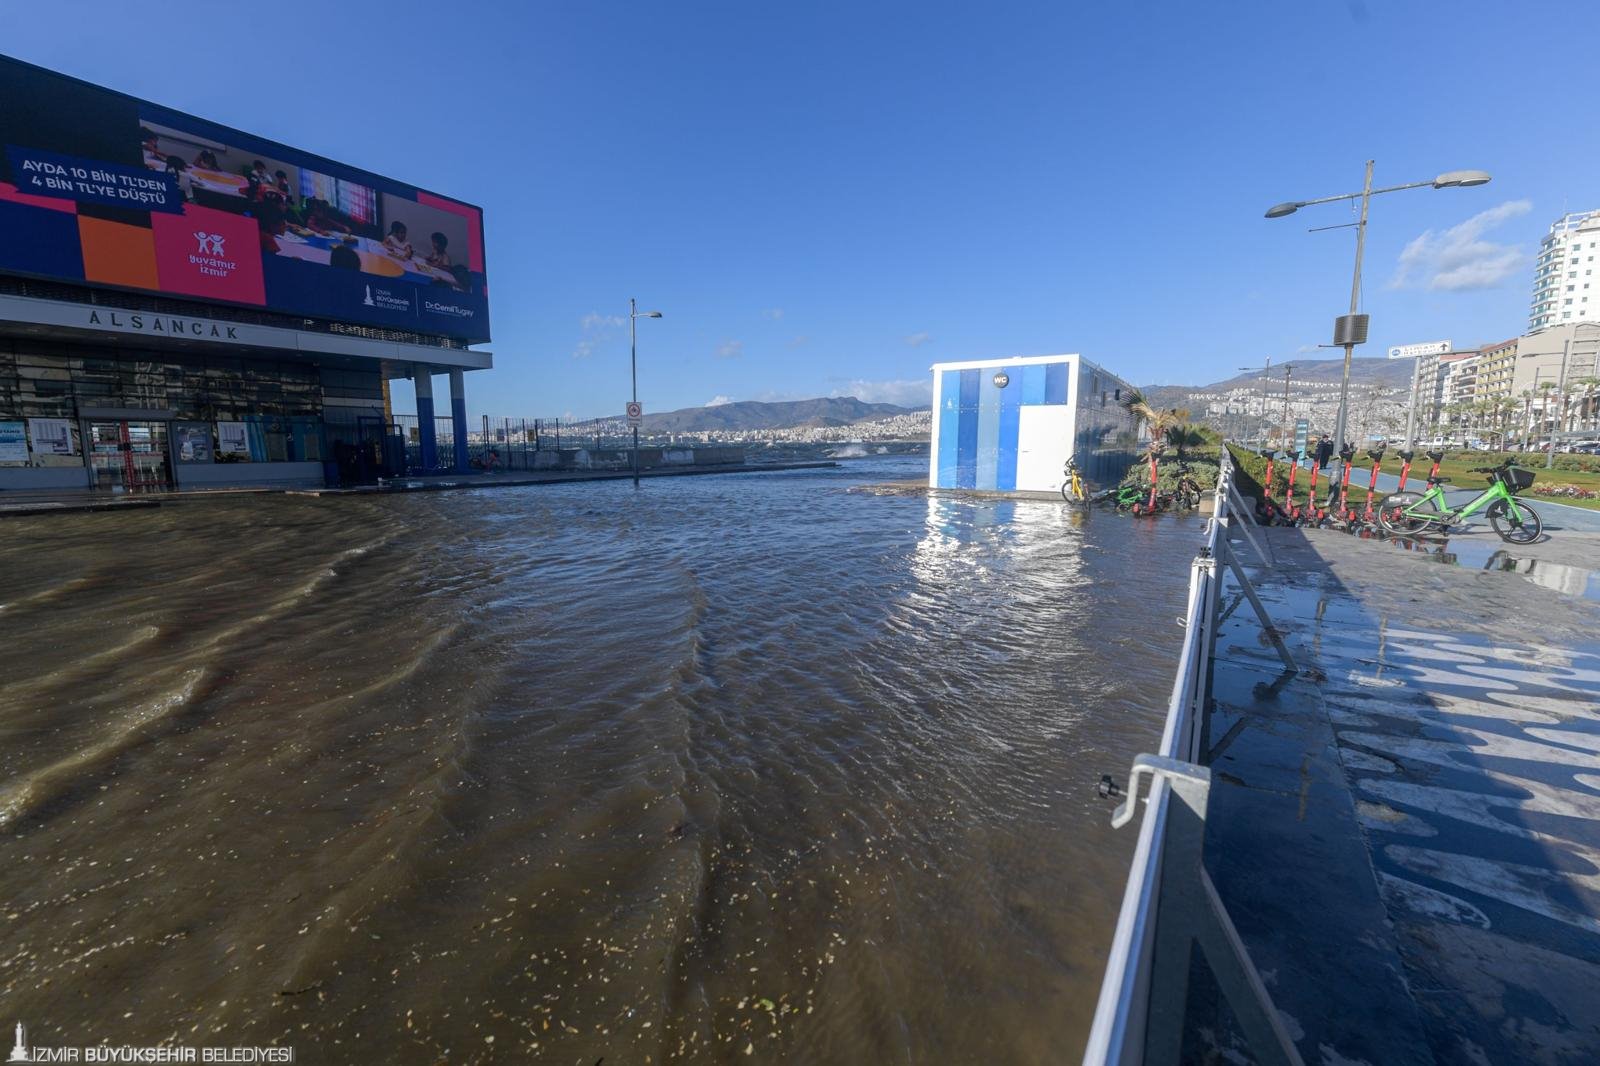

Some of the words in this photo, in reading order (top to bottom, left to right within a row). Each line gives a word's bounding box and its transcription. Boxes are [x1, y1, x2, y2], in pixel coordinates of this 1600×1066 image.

[23, 160, 68, 177] AYDA
[70, 167, 88, 179] 10
[90, 169, 116, 184] BİN
[119, 175, 167, 192] TL'DEN
[32, 175, 42, 187] 4
[45, 177, 74, 191] BİN
[76, 182, 116, 198] TL'YE
[119, 188, 166, 205] DÜŞTÜ
[200, 264, 229, 277] izmir
[89, 311, 238, 339] ALSANCAK
